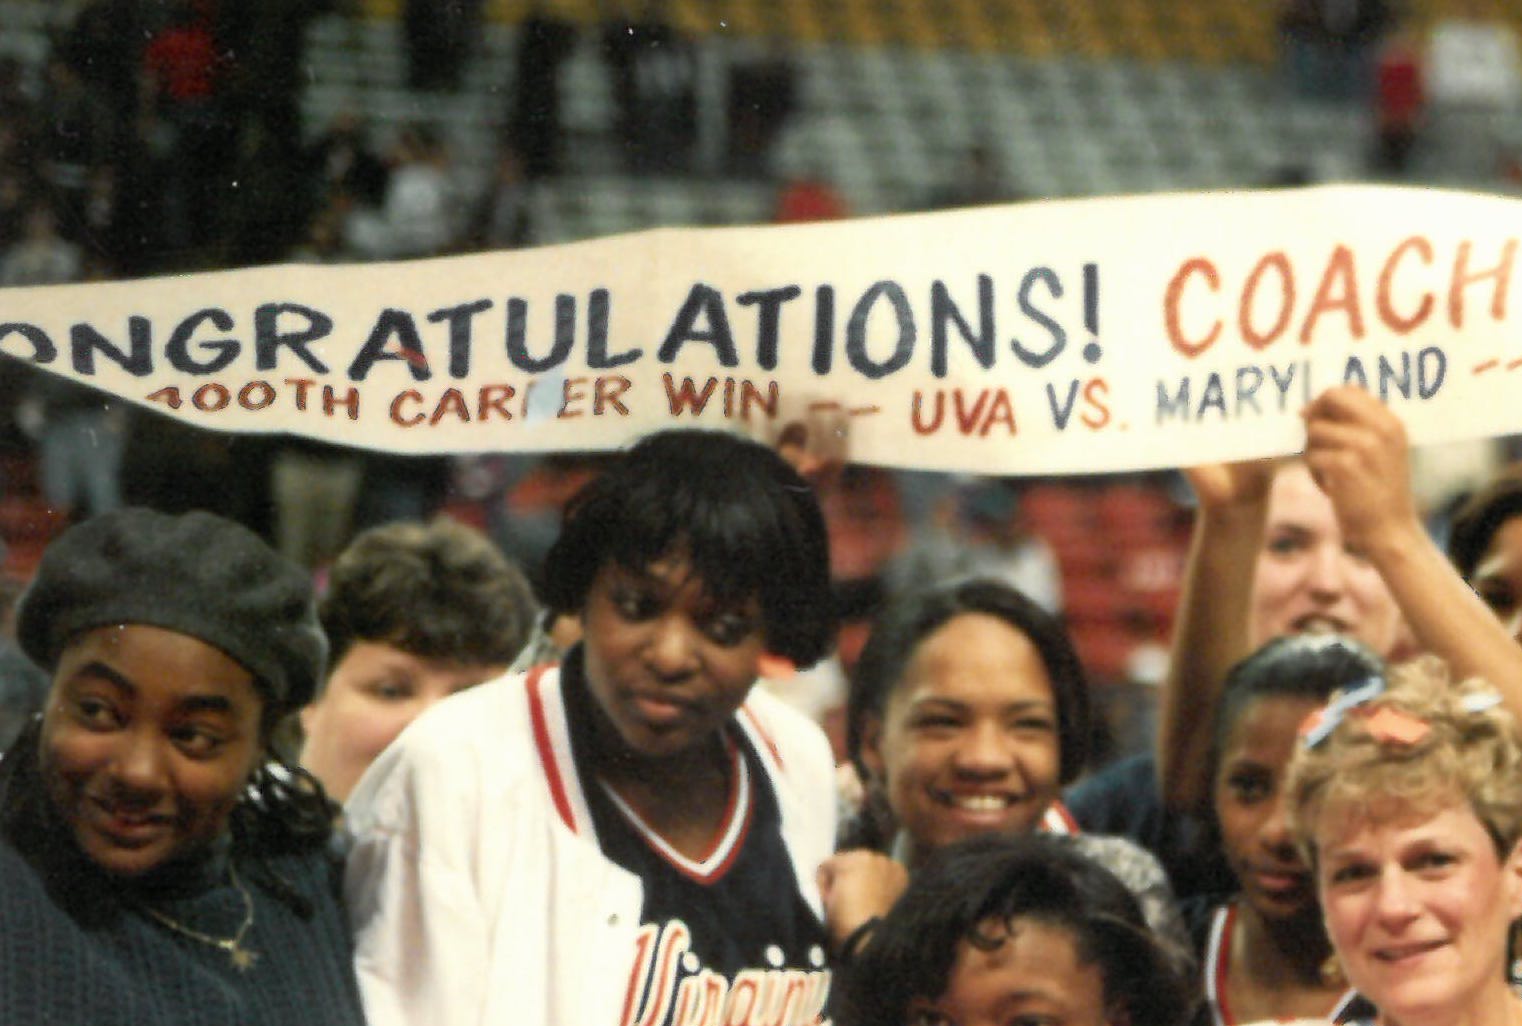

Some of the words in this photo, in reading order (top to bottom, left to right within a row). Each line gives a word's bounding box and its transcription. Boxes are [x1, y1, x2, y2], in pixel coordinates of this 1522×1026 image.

[1163, 235, 1518, 360] COACH
[389, 375, 633, 428] CARER
[661, 372, 780, 421] WIN
[910, 387, 1018, 437] UVA
